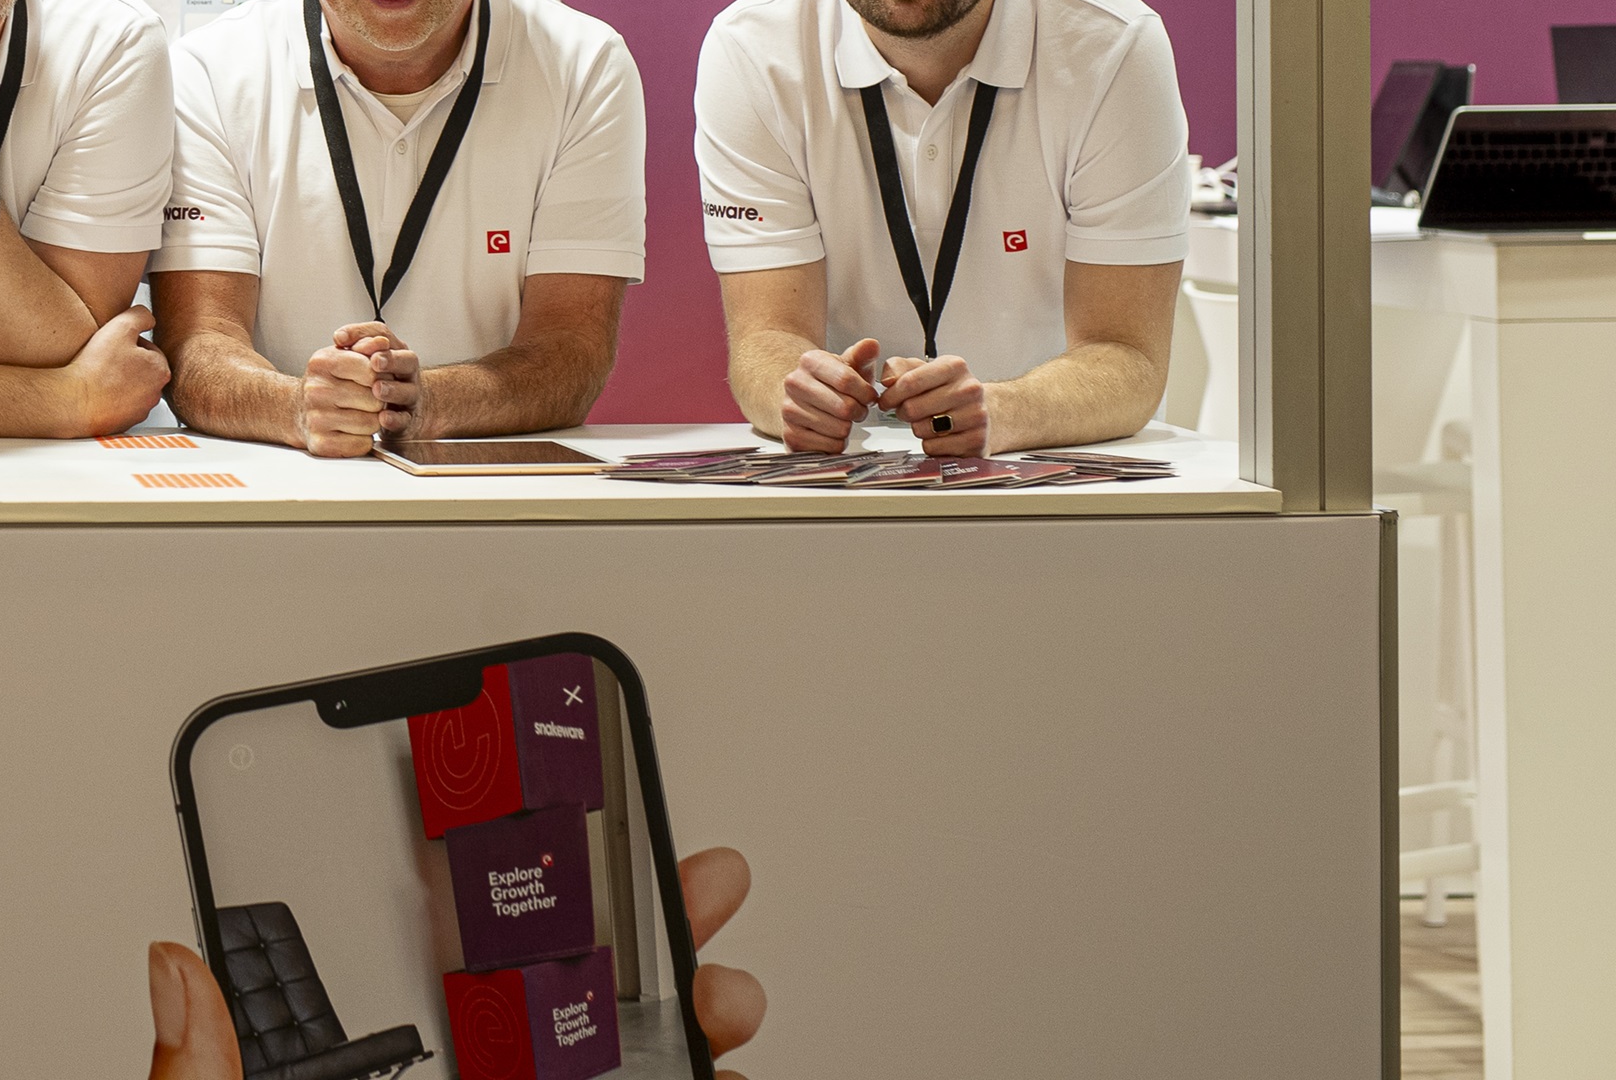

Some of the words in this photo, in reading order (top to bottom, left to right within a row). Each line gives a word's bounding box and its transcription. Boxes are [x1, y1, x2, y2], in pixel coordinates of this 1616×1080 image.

[488, 866, 543, 887] Explore
[490, 880, 545, 901] Growth
[492, 896, 557, 917] Together
[552, 1001, 588, 1021] Explore
[554, 1013, 589, 1034] Growth
[556, 1024, 597, 1047] Together
